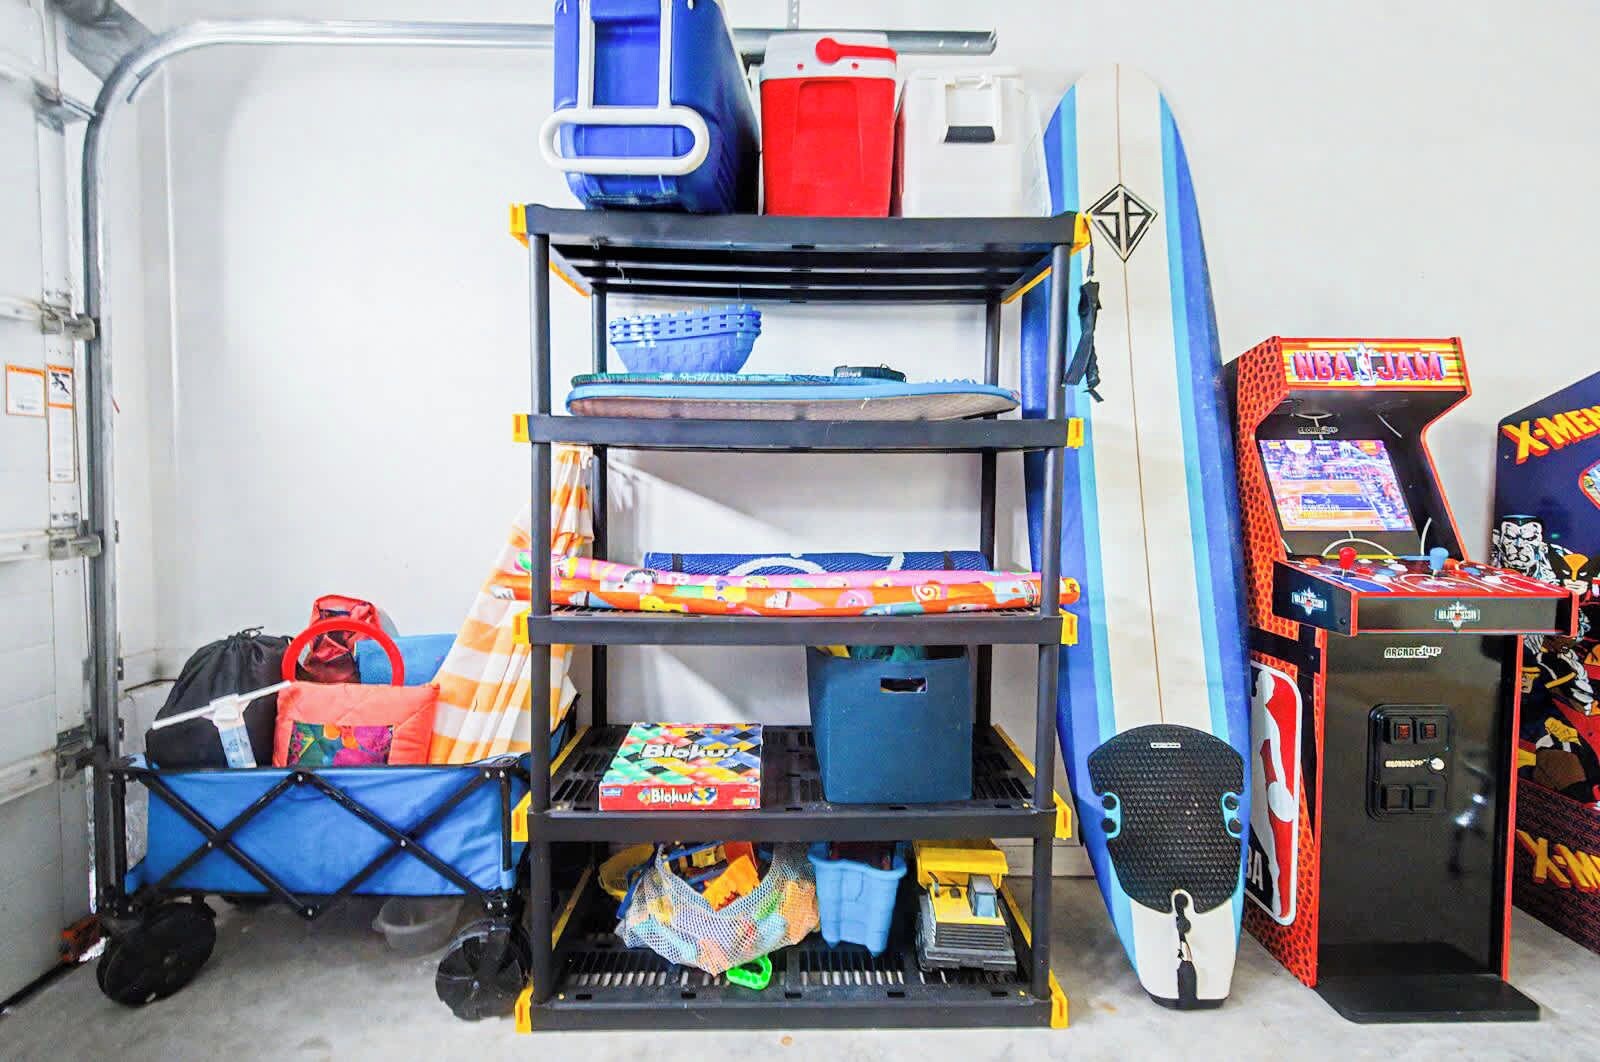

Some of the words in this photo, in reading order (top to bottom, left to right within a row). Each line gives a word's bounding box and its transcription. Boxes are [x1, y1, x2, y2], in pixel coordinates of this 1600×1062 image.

[1293, 351, 1355, 381] NBA
[1376, 351, 1444, 381] JAM
[640, 743, 738, 762] Blokus
[651, 787, 693, 806] Blokus
